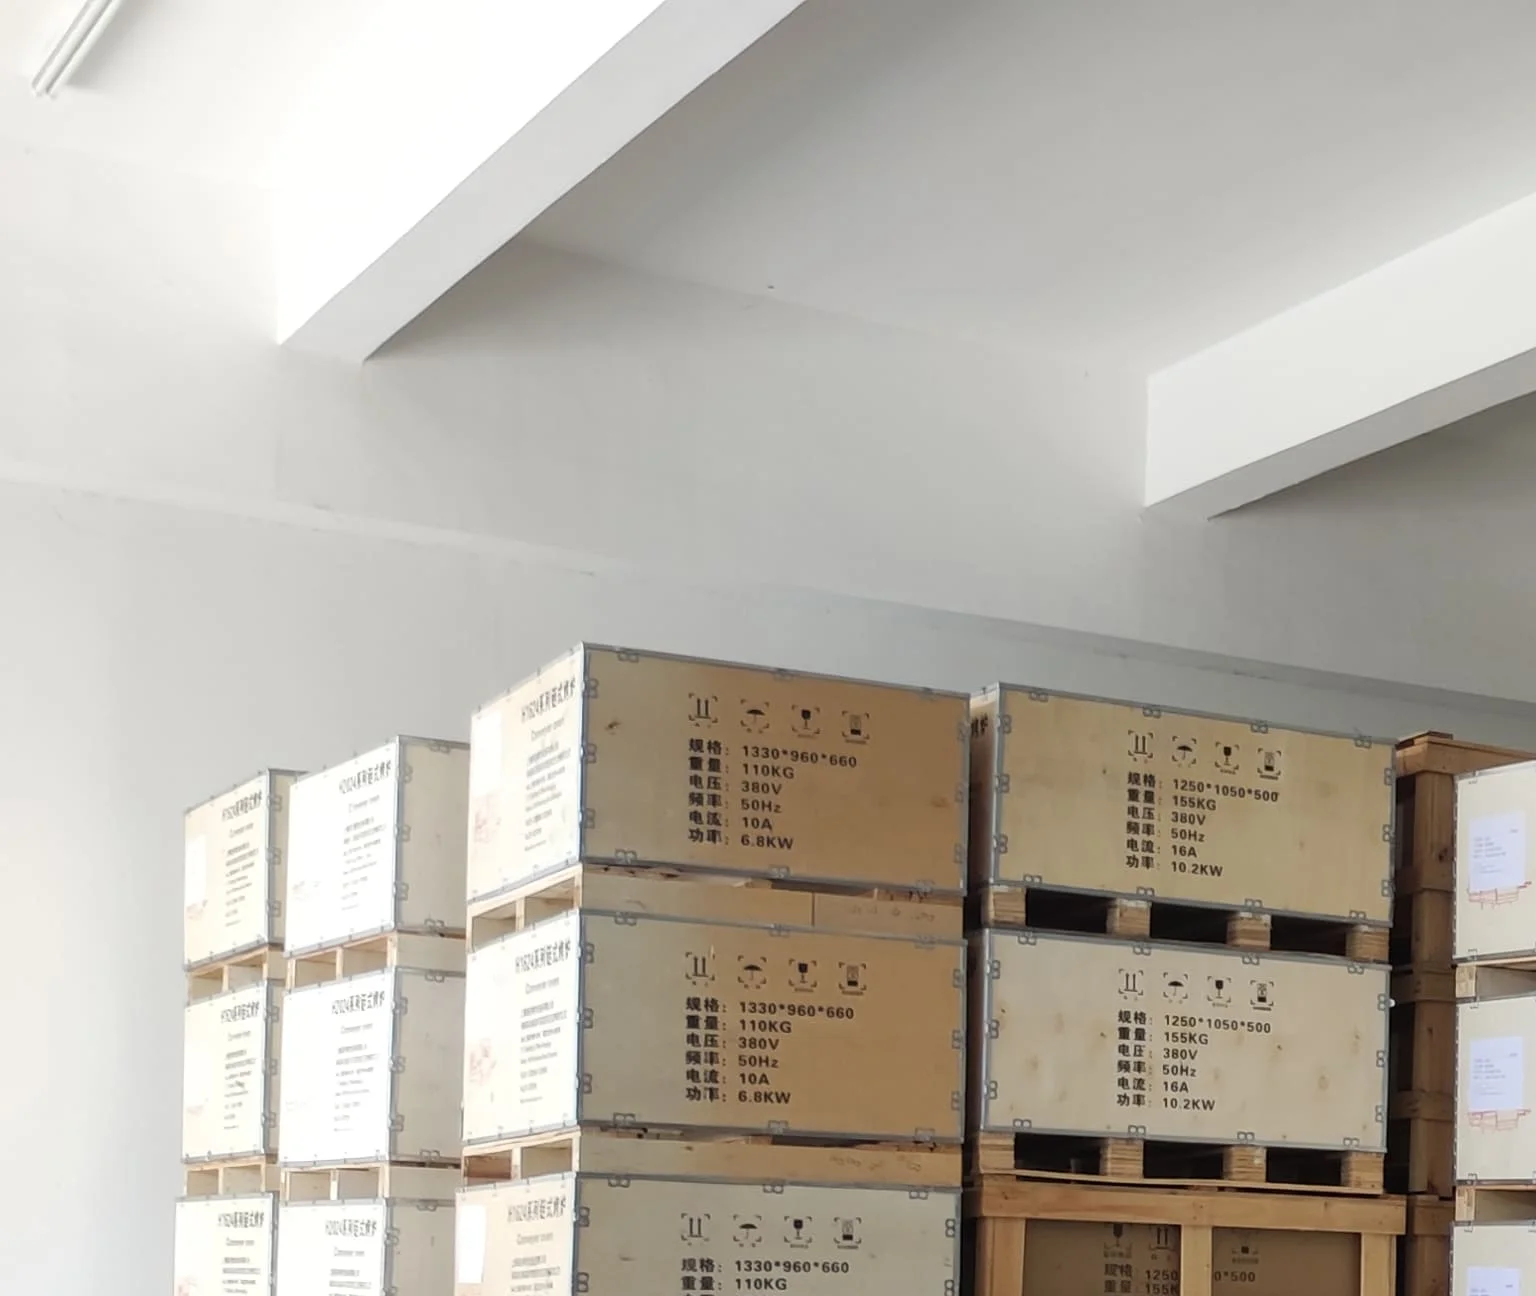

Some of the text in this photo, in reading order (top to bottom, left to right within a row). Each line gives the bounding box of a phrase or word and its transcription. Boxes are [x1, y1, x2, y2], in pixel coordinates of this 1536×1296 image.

[743, 763, 794, 779] 110KG
[742, 780, 782, 795] 380V
[741, 798, 781, 813] 50Hz
[1173, 795, 1216, 811] 155KG
[742, 817, 772, 831] 10A
[1171, 811, 1206, 826] 380V
[741, 834, 793, 849] 6.8KW
[1171, 828, 1205, 842] 50Hz
[1172, 845, 1197, 858] 16A
[1171, 861, 1223, 877] 10.2KW
[740, 1019, 791, 1033] 110KG
[739, 1036, 779, 1050] 380V
[1164, 1032, 1208, 1048] 155KG
[1163, 1048, 1198, 1060] 380V
[738, 1055, 778, 1068] 50Hz
[1162, 1063, 1196, 1077] 50Hz
[739, 1073, 770, 1085] 10A
[1163, 1081, 1189, 1093] 16A
[738, 1090, 791, 1104] 6.8KW
[1163, 1097, 1215, 1111] 10.2KW
[735, 1278, 787, 1290] 110KG
